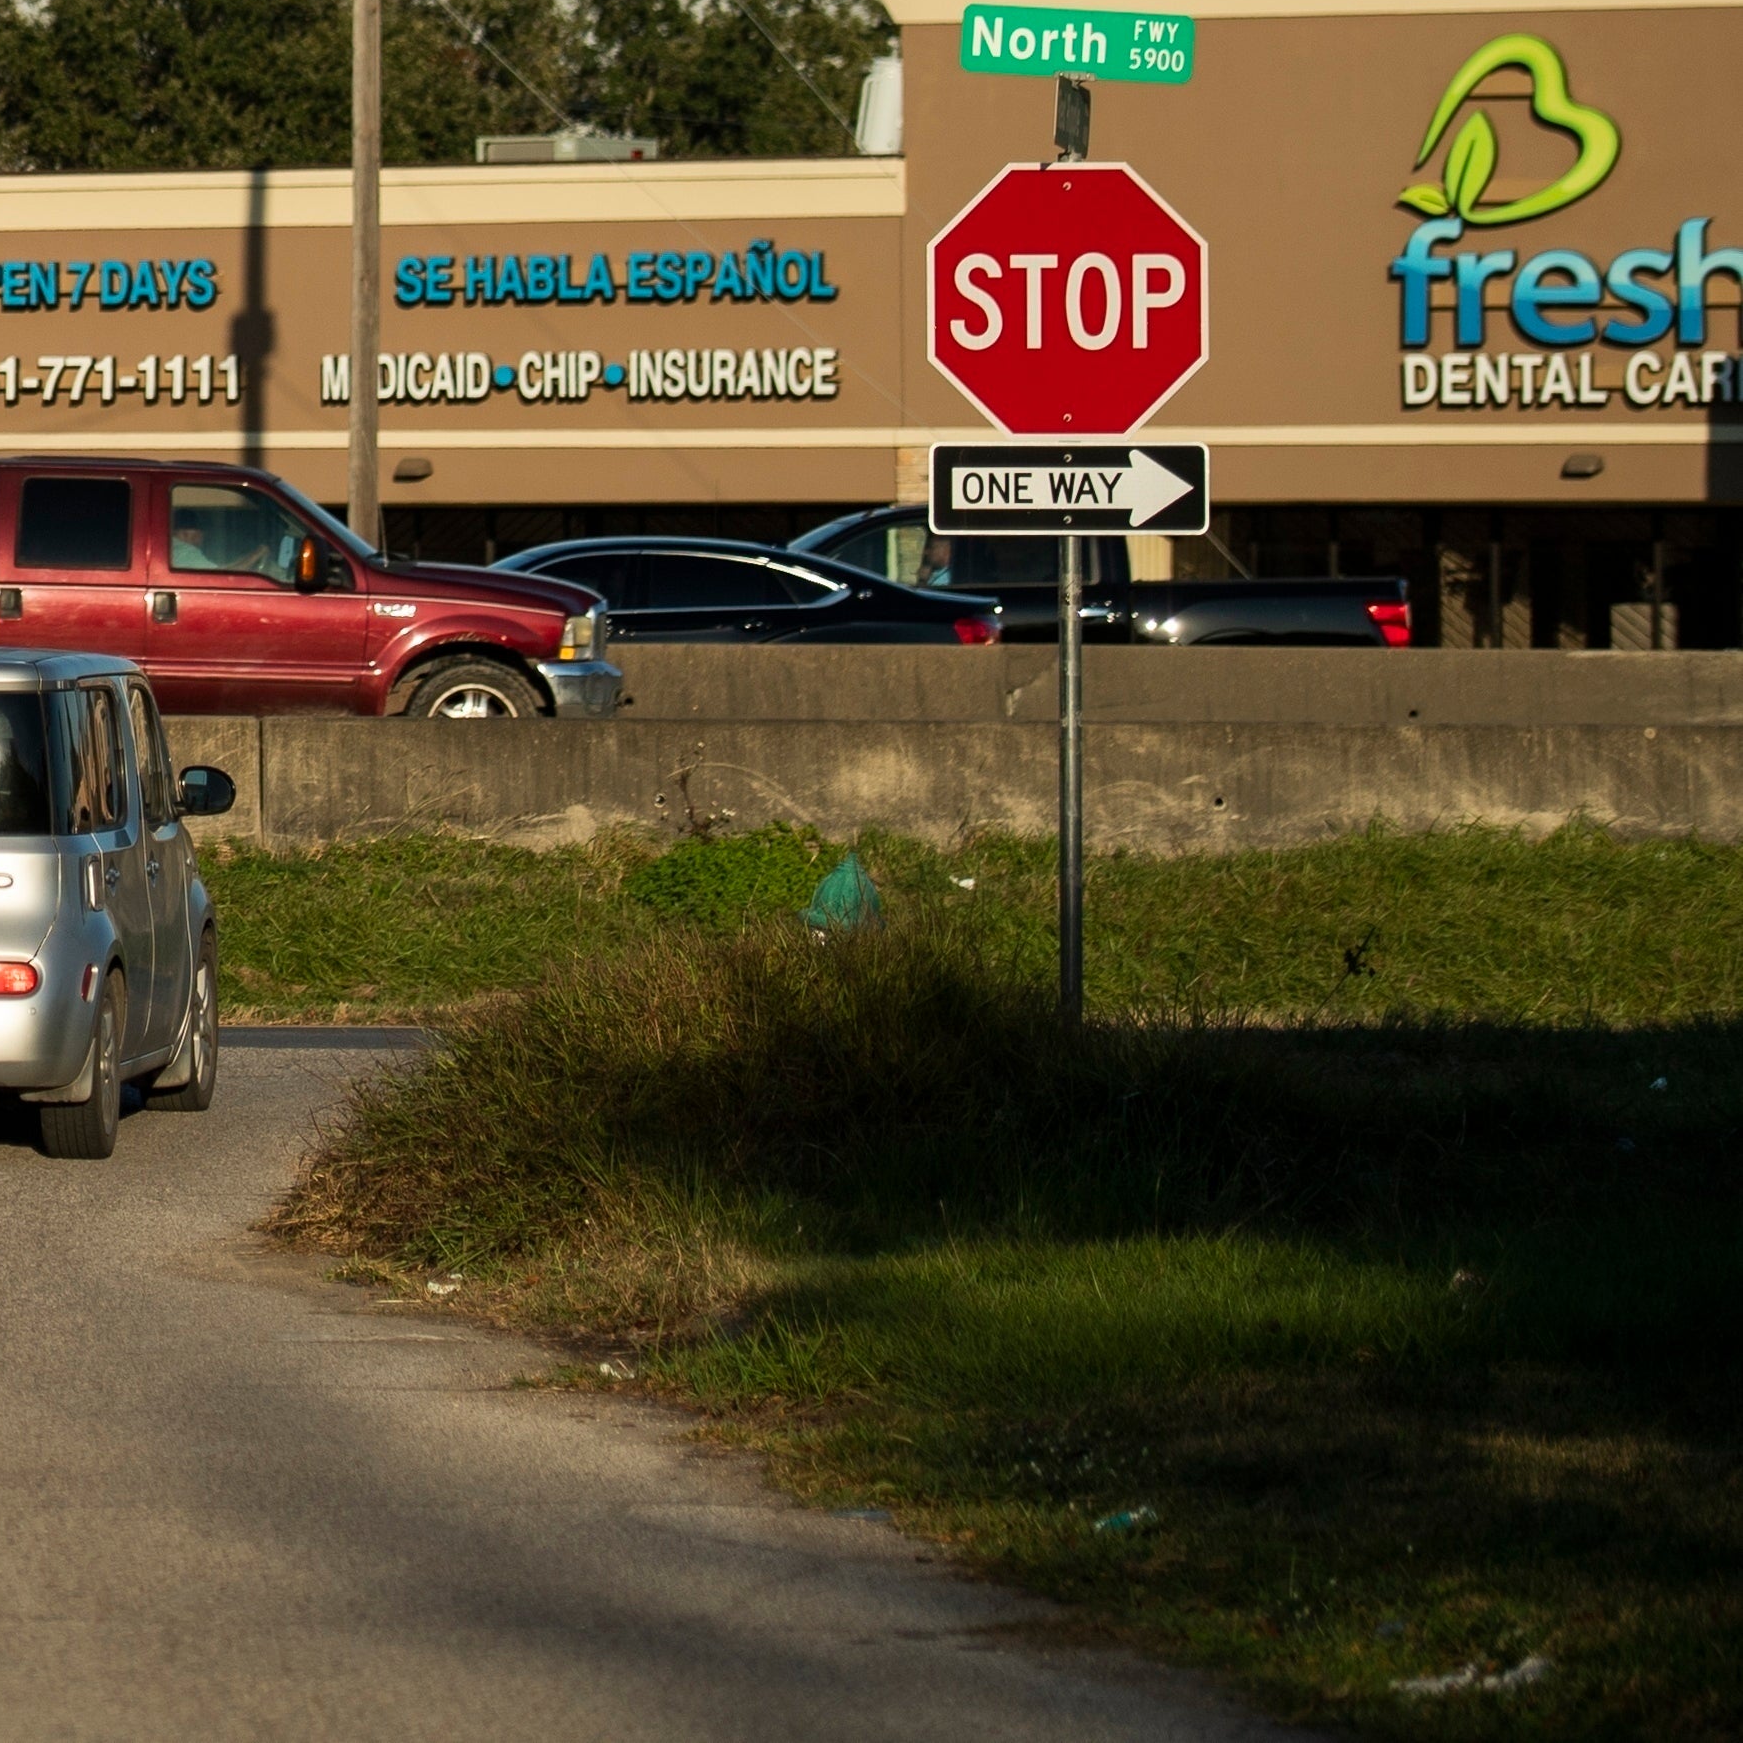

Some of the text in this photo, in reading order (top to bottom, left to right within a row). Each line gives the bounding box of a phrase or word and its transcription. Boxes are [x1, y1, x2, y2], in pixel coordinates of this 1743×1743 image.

[971, 15, 1179, 65] North FWY
[1129, 48, 1186, 73] 5900
[69, 262, 93, 306] 7
[100, 260, 216, 306] DAYS
[396, 238, 837, 303] SE HABLA ESPAÑOL
[1392, 218, 1743, 346] fresh
[950, 252, 1186, 351] STOP
[322, 346, 838, 400] MDICAID CHIP INSURANCE
[1403, 351, 1743, 405] DENTAL CAR
[962, 472, 1123, 504] ONE WAY
